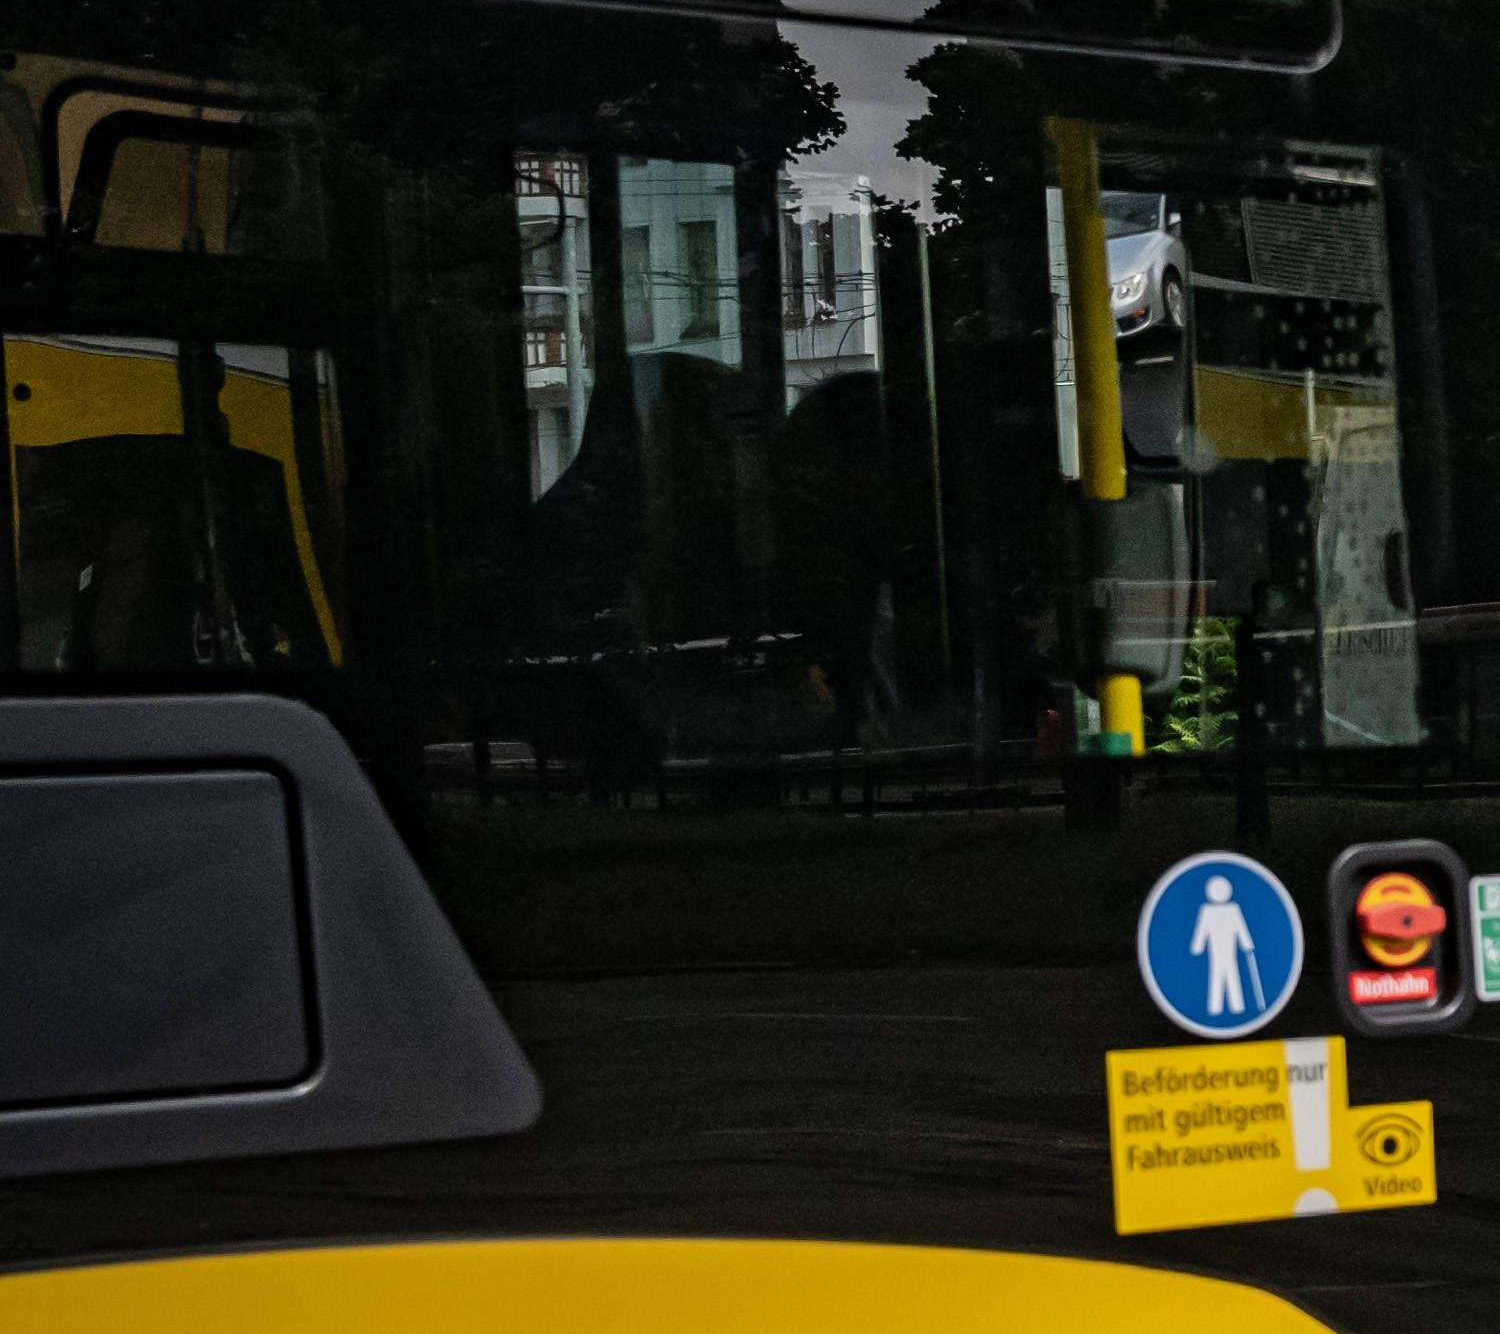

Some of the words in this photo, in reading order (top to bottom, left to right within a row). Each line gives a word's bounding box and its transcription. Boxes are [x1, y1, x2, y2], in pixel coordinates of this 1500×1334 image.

[1355, 977, 1429, 998] Nothahn
[1122, 1063, 1280, 1097] Beförderung
[1287, 1062, 1328, 1083] nur
[1124, 1107, 1165, 1133] mit
[1175, 1099, 1285, 1140] gültigem
[1126, 1137, 1282, 1171] Fahrausweis
[1362, 1173, 1423, 1197] Video
